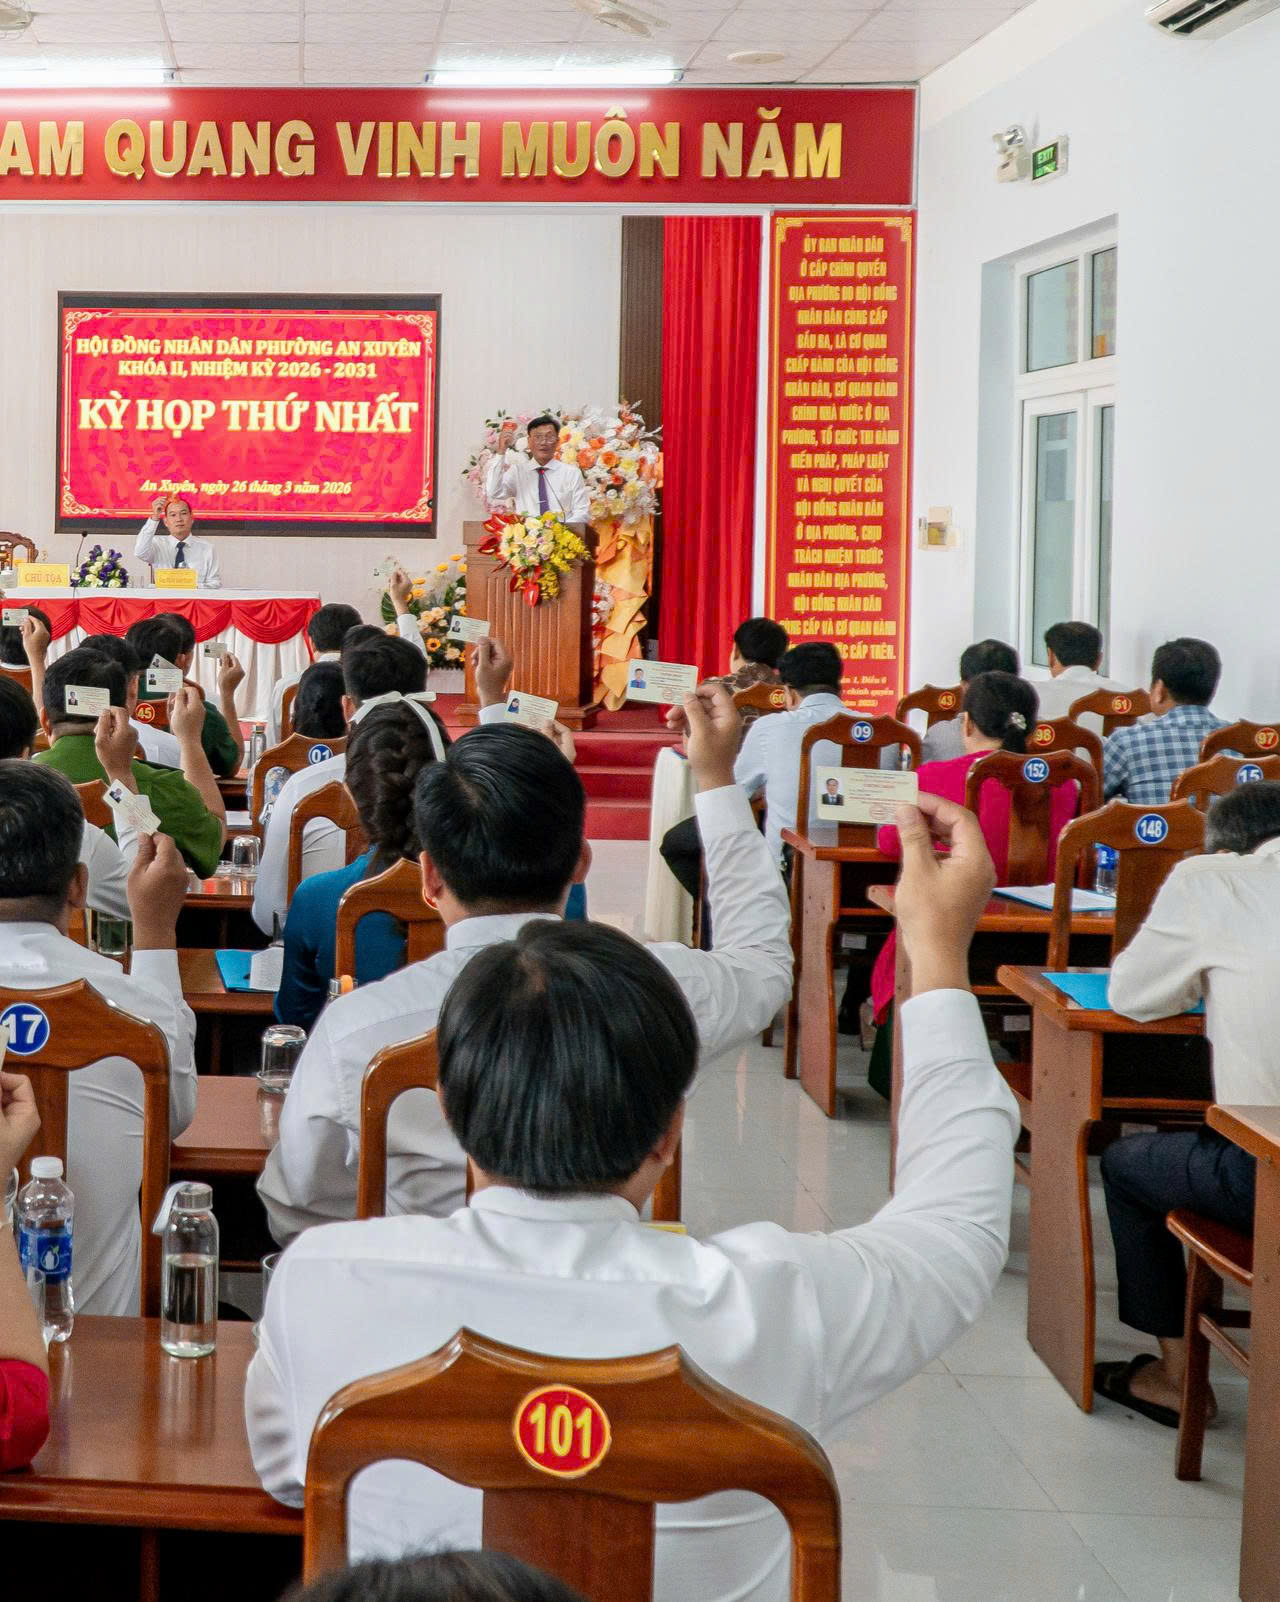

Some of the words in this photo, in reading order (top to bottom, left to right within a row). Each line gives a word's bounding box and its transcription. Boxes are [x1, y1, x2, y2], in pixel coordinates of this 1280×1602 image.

[104, 119, 315, 179] QUANG
[336, 121, 479, 178] VINH
[500, 106, 680, 178] MUÔN
[703, 108, 843, 179] NĂM
[76, 336, 109, 357] HỘI
[112, 334, 161, 355] ĐỒNG
[163, 337, 215, 355] NHÂN
[217, 337, 253, 355] DÂN
[256, 337, 334, 357] PHƯỜNG
[336, 341, 361, 357] AN
[363, 338, 422, 358] XUYÊN
[119, 357, 169, 377] KHÓA
[171, 361, 187, 379] II,
[191, 359, 248, 380] NHIỆM
[251, 358, 276, 377] KỲ
[278, 362, 322, 378] 2026
[334, 363, 377, 379] 2031
[78, 390, 128, 430] KỲ
[136, 399, 215, 438] HỌP
[222, 392, 309, 431] THỨ
[315, 392, 418, 433] NHẤT
[140, 480, 157, 493] An
[159, 479, 198, 495] Xuyên,
[201, 482, 229, 496] ngày
[231, 481, 247, 493] 26
[249, 481, 282, 497] tháng
[285, 482, 292, 494] 3
[295, 481, 320, 494] năm
[323, 482, 352, 495] 2026
[137, 708, 152, 720] 45
[854, 726, 871, 738] 09
[1035, 729, 1052, 741] 98
[1258, 732, 1275, 744] 97
[311, 748, 330, 762] 01
[1028, 763, 1045, 777] 152
[1140, 820, 1162, 838] 148
[2, 1012, 43, 1045] 17
[528, 1403, 595, 1457] 101
